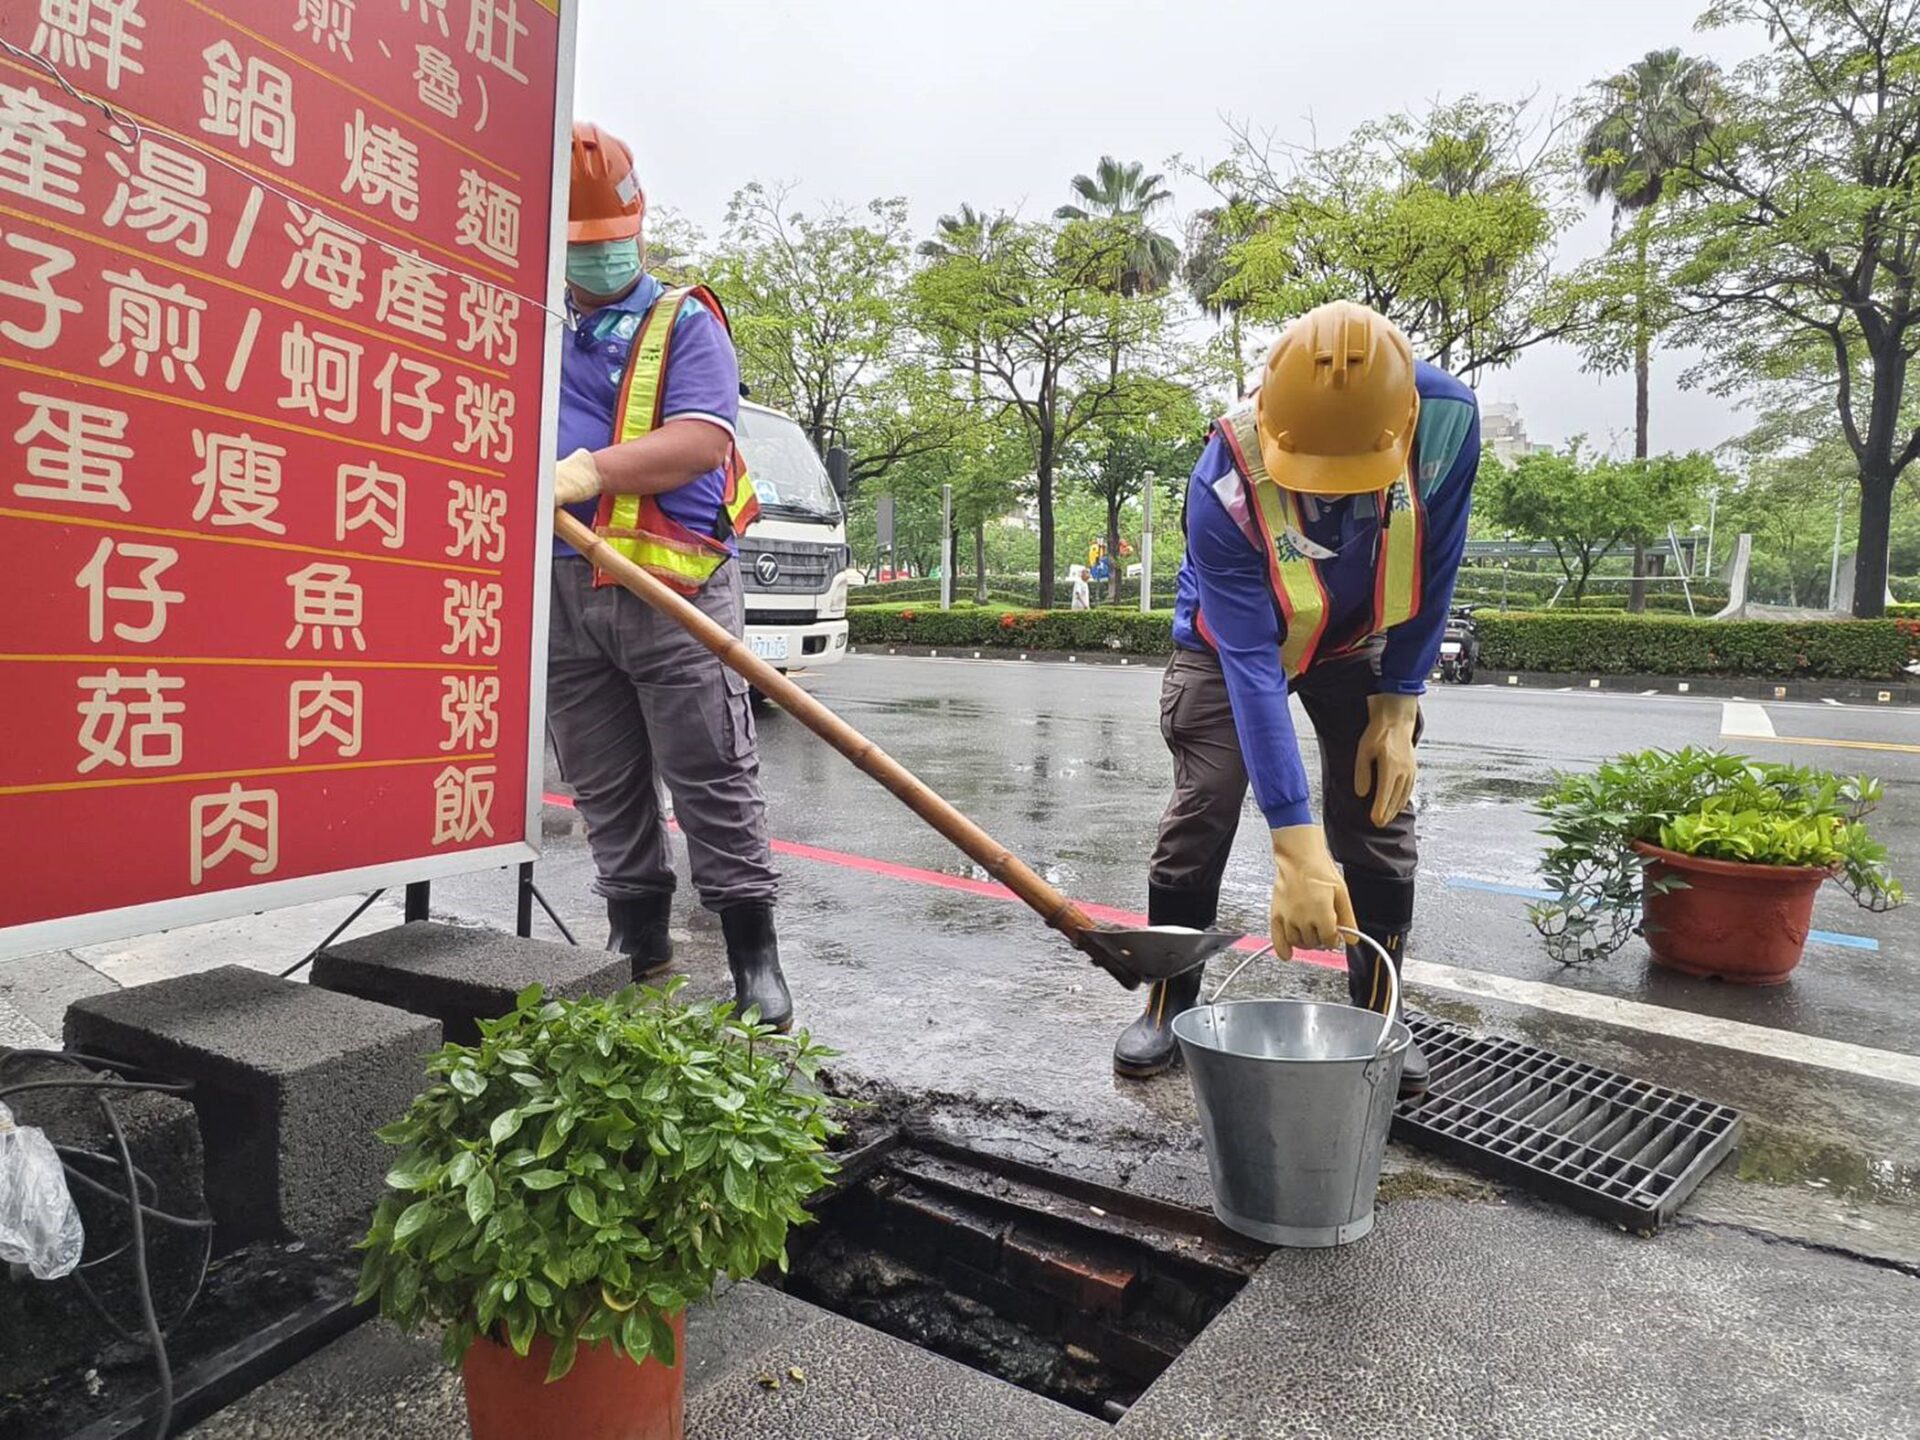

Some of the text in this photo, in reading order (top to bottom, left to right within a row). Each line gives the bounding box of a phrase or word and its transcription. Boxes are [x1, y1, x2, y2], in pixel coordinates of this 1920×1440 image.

[15, 391, 507, 563] 蛋瘦肉粥
[76, 538, 502, 656] 仔魚粥
[77, 668, 499, 774] 菇肉粥
